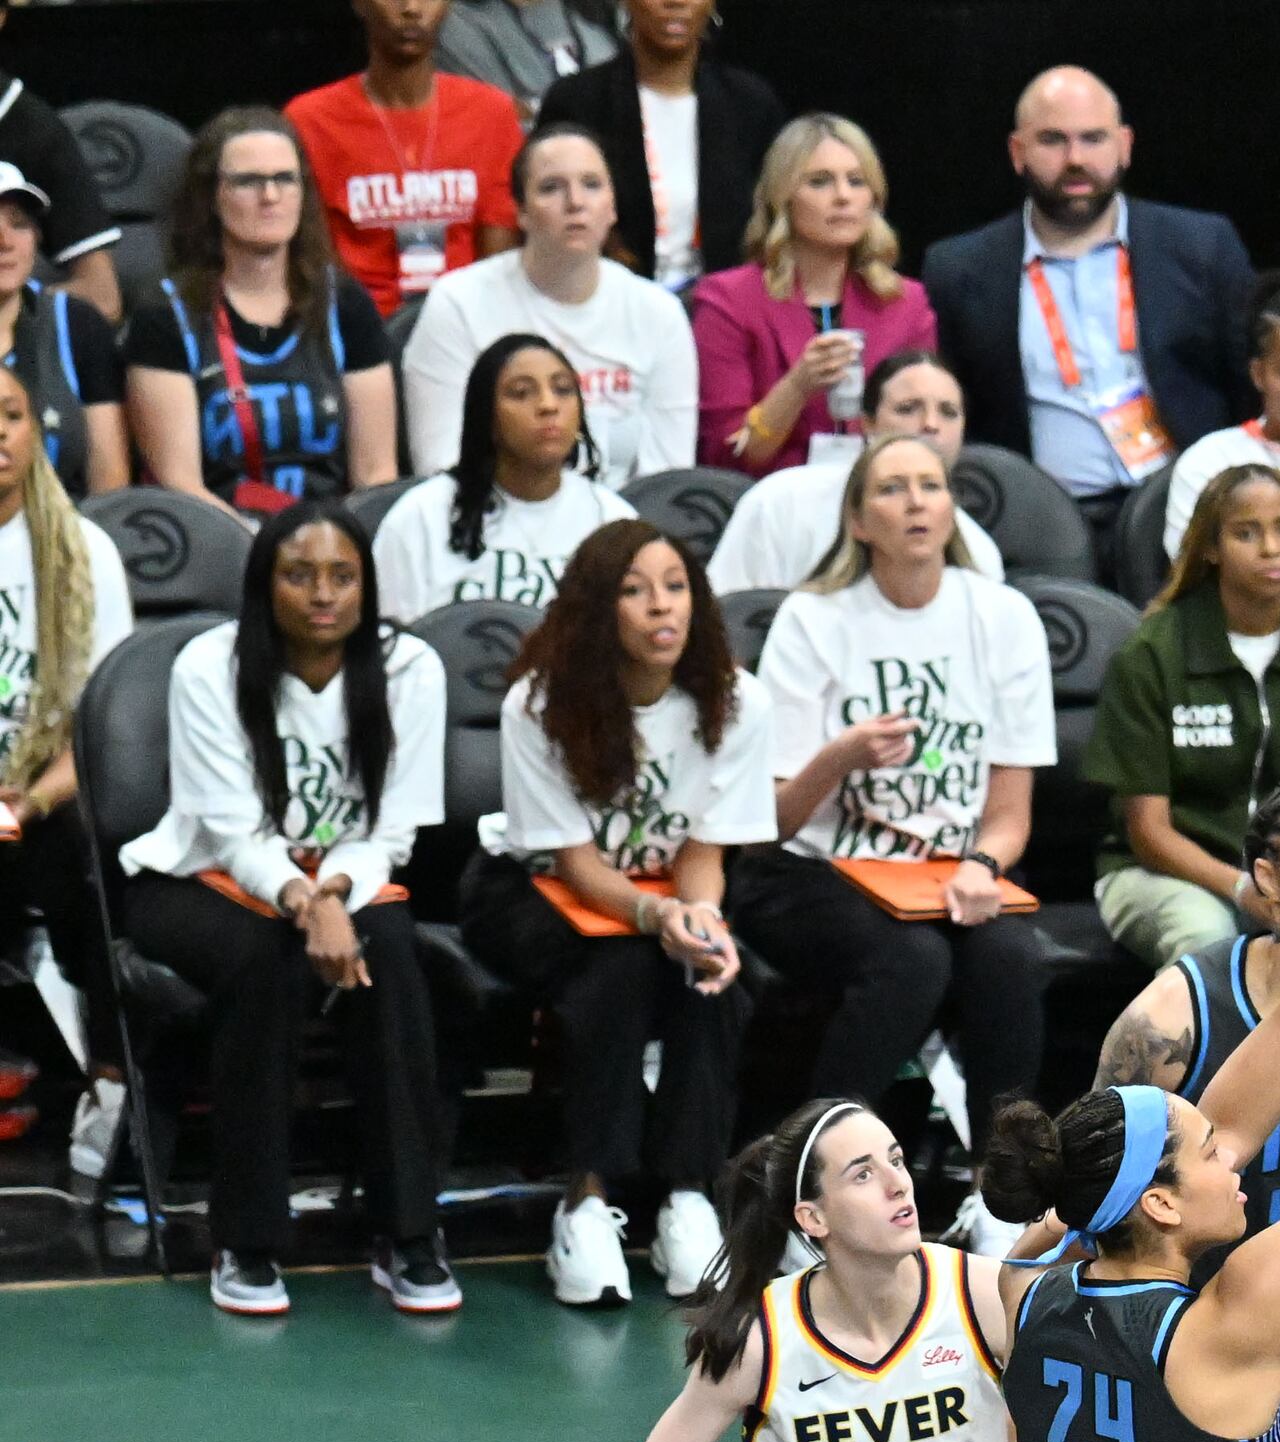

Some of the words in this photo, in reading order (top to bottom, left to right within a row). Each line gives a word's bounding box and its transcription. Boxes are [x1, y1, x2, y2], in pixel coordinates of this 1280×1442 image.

[347, 169, 478, 214] ATLANTA
[870, 655, 951, 720] Pay
[922, 1345, 965, 1367] Lilly
